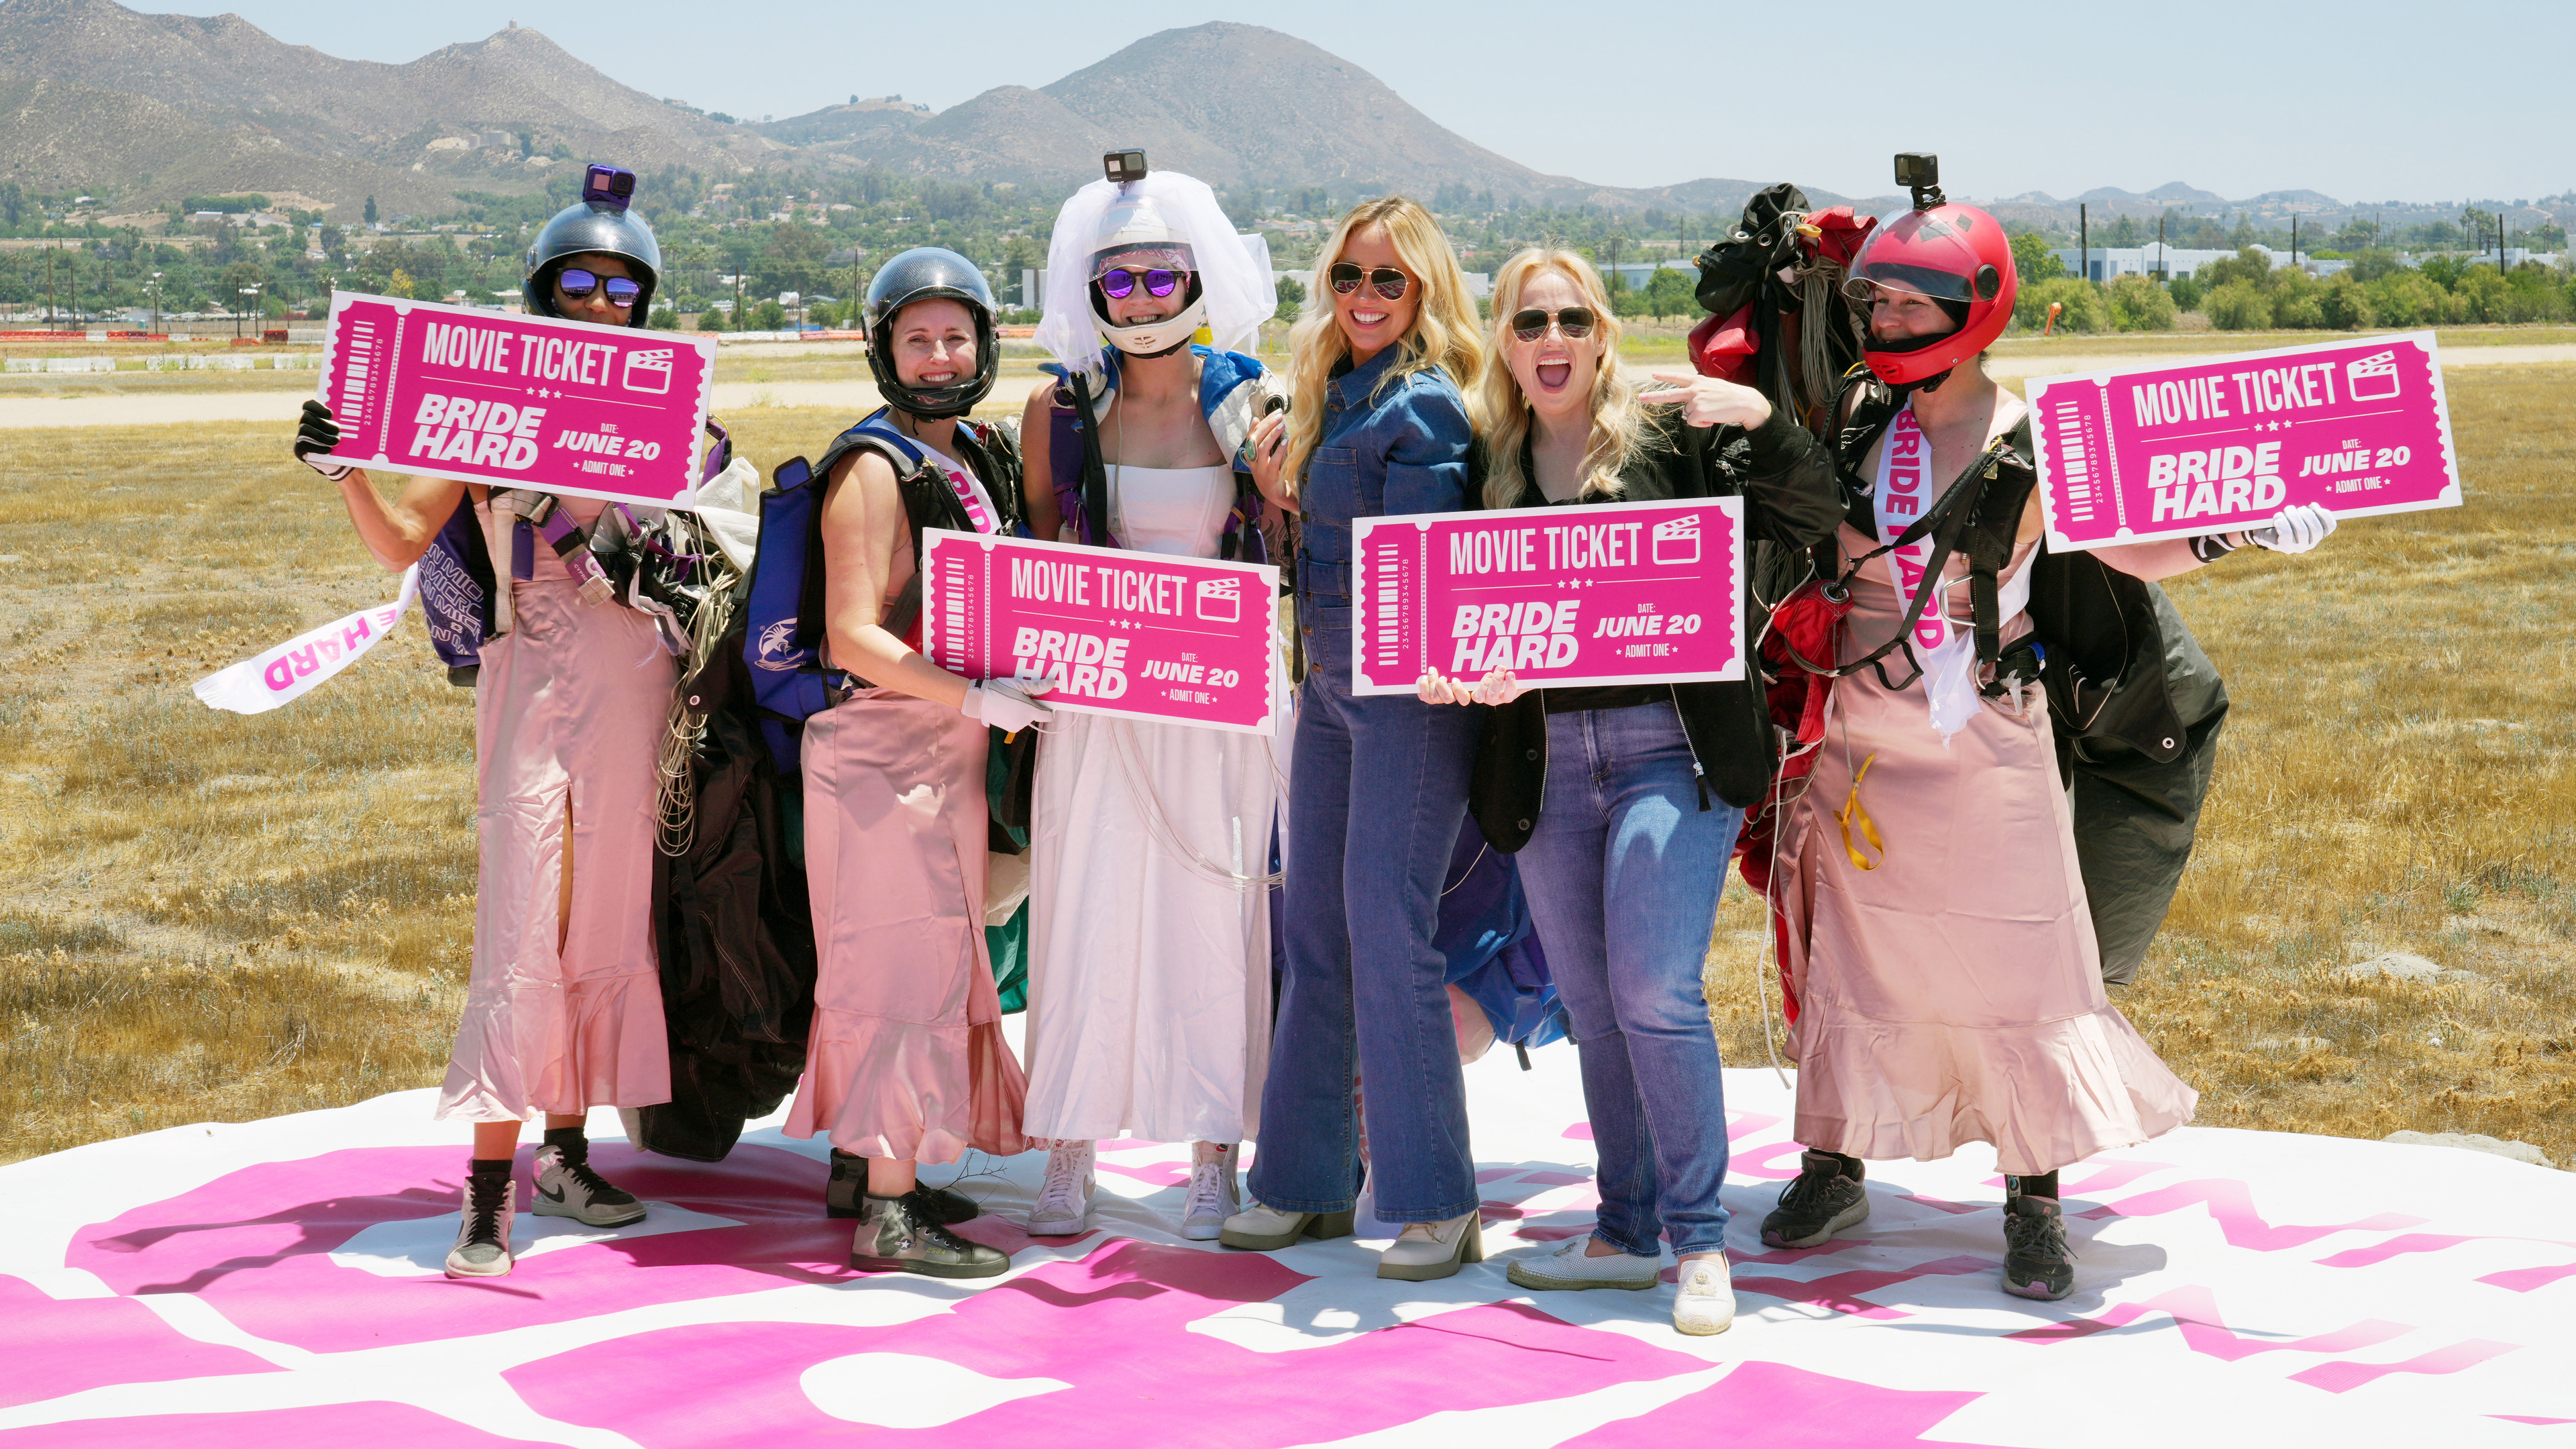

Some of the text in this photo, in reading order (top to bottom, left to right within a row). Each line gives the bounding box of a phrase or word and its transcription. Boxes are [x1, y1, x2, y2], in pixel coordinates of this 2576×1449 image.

[423, 323, 618, 386] MOVIE TICKET
[364, 339, 383, 425] 23456789345678
[2133, 362, 2336, 427] MOVIE TICKET
[414, 394, 547, 438] BRIDE
[601, 423, 618, 433] DATE:
[409, 425, 538, 470] HARD
[553, 430, 660, 460] JUNE 20
[1886, 409, 1922, 515] BRIDE
[2084, 415, 2104, 504] 23456789345678
[2299, 446, 2410, 477] JUNE 20
[2343, 439, 2361, 449] DATE:
[582, 460, 626, 476] ADMIT ONE
[2148, 441, 2282, 488] BRIDE
[2152, 475, 2286, 522] HARD
[2336, 476, 2382, 493] ADMIT ONE
[1450, 523, 1642, 574] MOVIE TICKET
[574, 564, 588, 582] CYPRE
[1012, 558, 1187, 616] MOVIE TICKET
[1452, 600, 1580, 637] BRIDE
[1593, 614, 1701, 638] JUNE 20
[1638, 603, 1655, 613] DATE:
[264, 616, 371, 691] HARD
[1012, 627, 1130, 668] BRIDE
[1182, 653, 1197, 662] DATE:
[1451, 633, 1579, 672] HARD
[1625, 643, 1669, 657] ADMIT ONE
[1013, 657, 1128, 700] HARD
[1140, 660, 1239, 688] JUNE 20
[1169, 689, 1210, 704] ADMIT ONE
